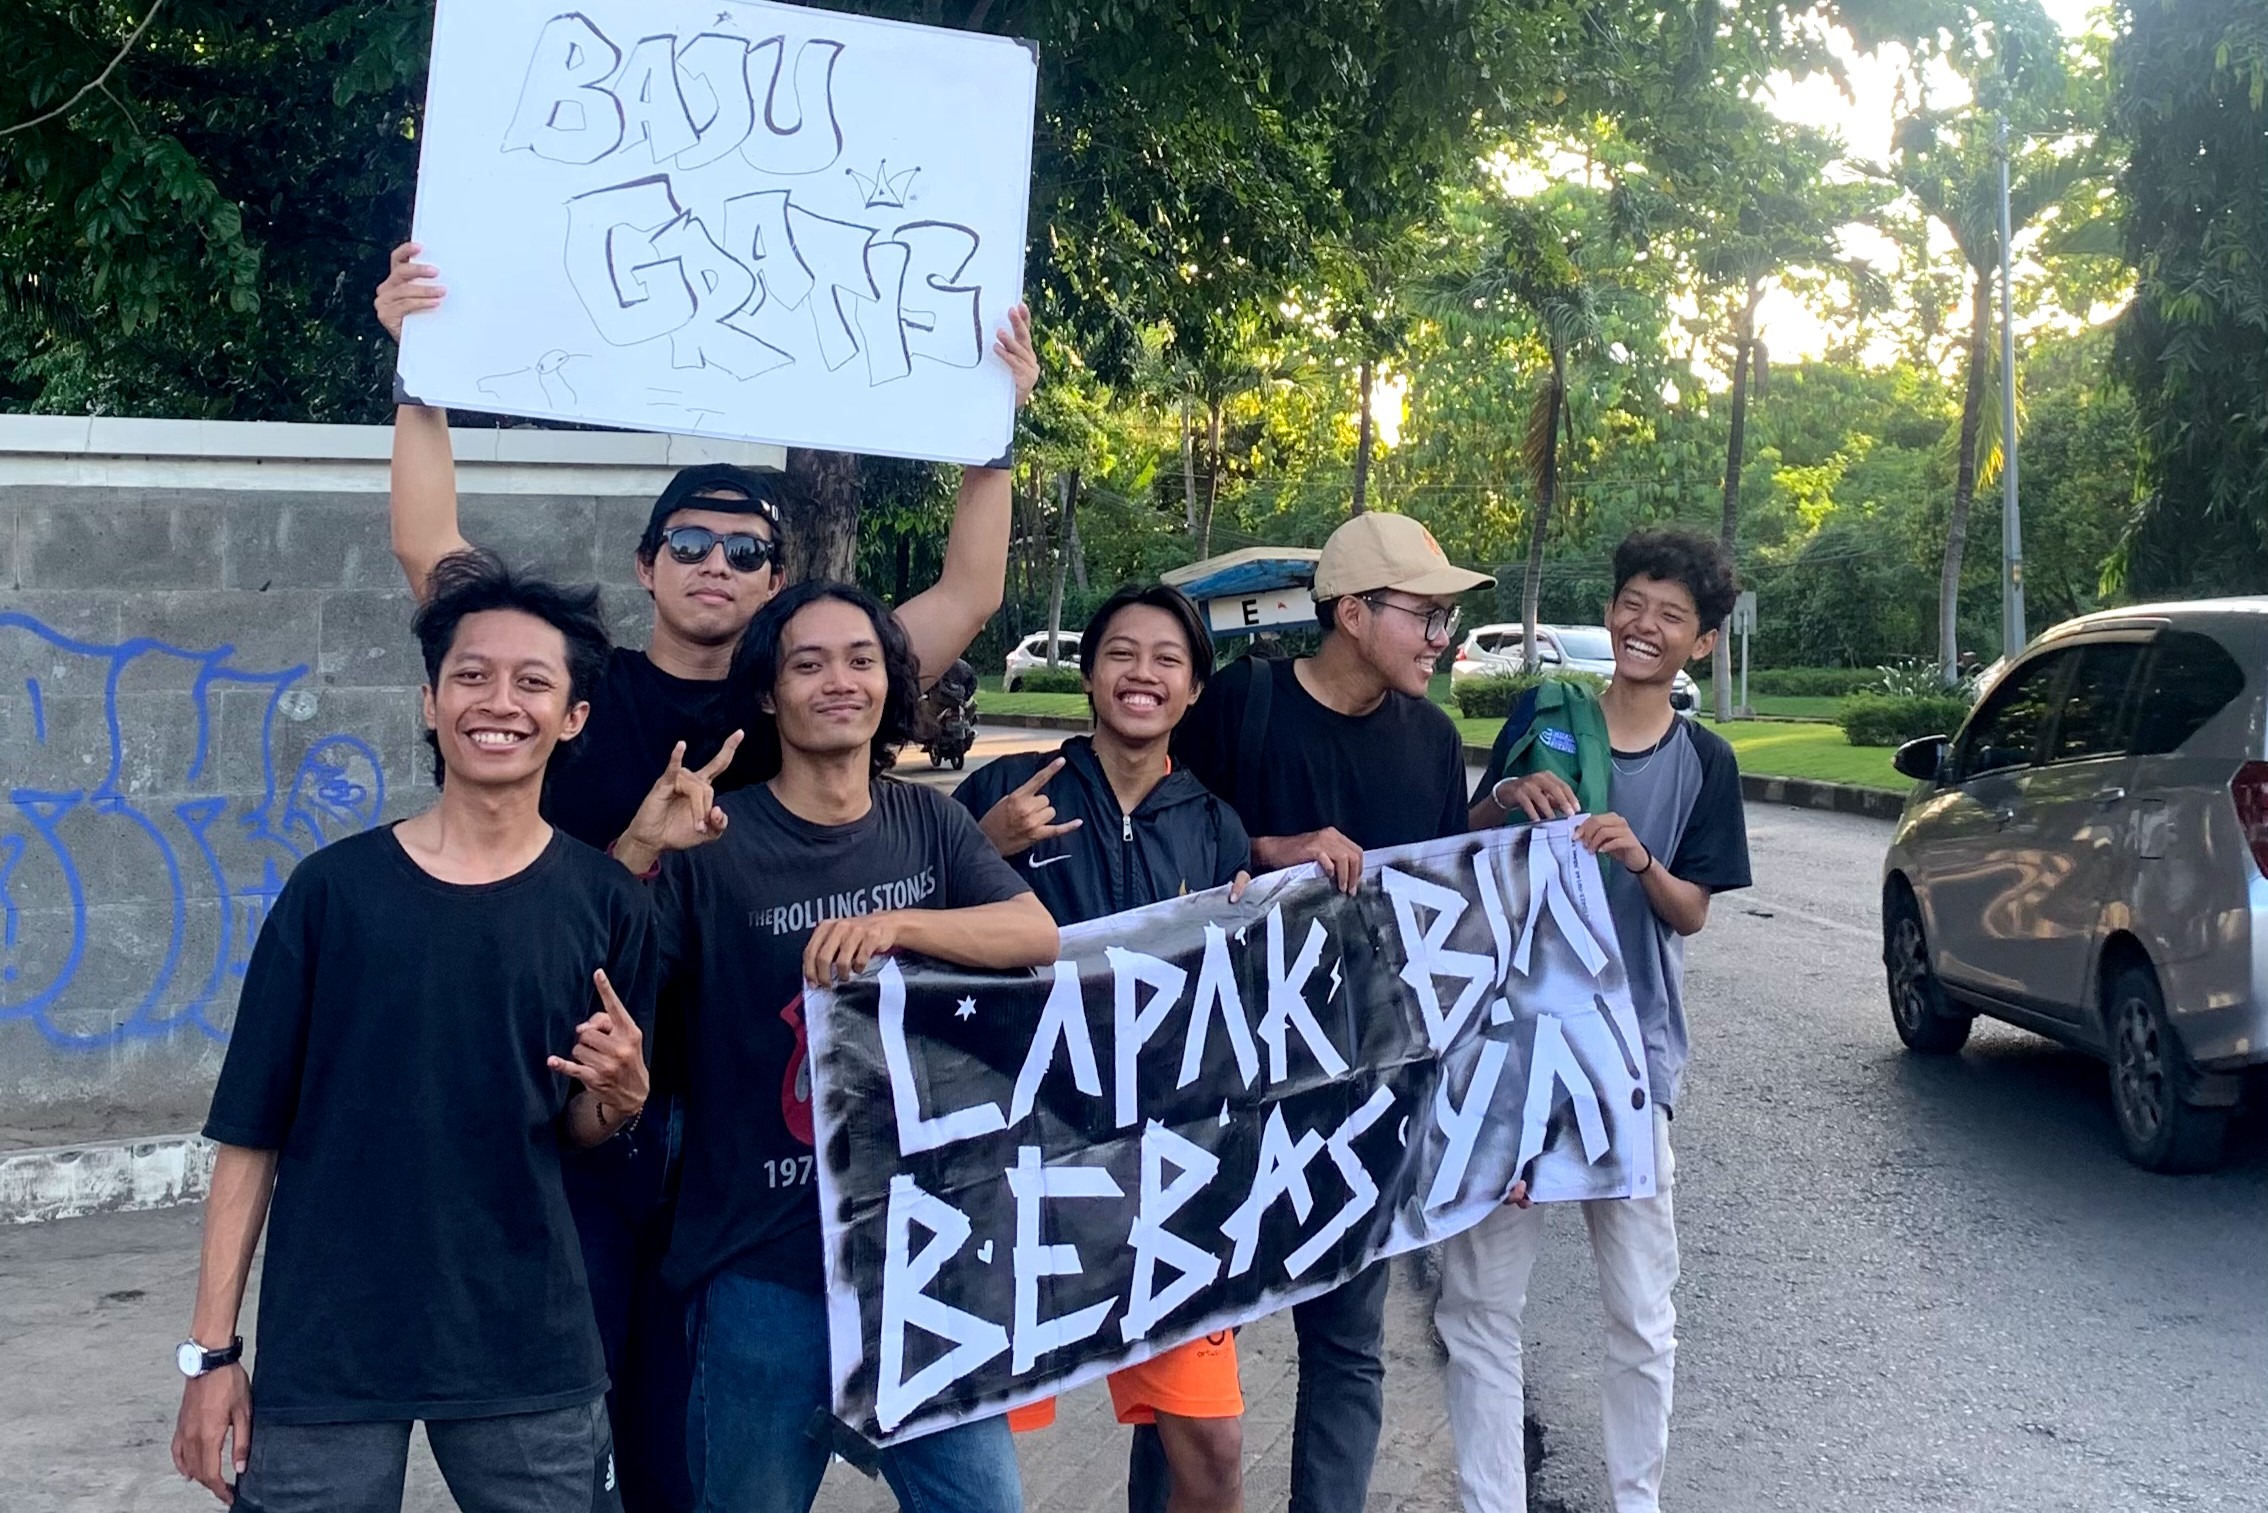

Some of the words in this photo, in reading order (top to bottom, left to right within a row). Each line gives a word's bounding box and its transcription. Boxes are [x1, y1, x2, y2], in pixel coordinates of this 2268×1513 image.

[501, 11, 845, 175] BAJU
[563, 173, 983, 388] GRATIS
[1241, 599, 1259, 626] E
[749, 908, 773, 927] THE
[773, 888, 869, 935] ROLLING
[871, 865, 936, 914] STONES
[878, 901, 1349, 1157] LAPAK
[763, 1155, 818, 1188] 197
[873, 1084, 1397, 1433] BEBAS
